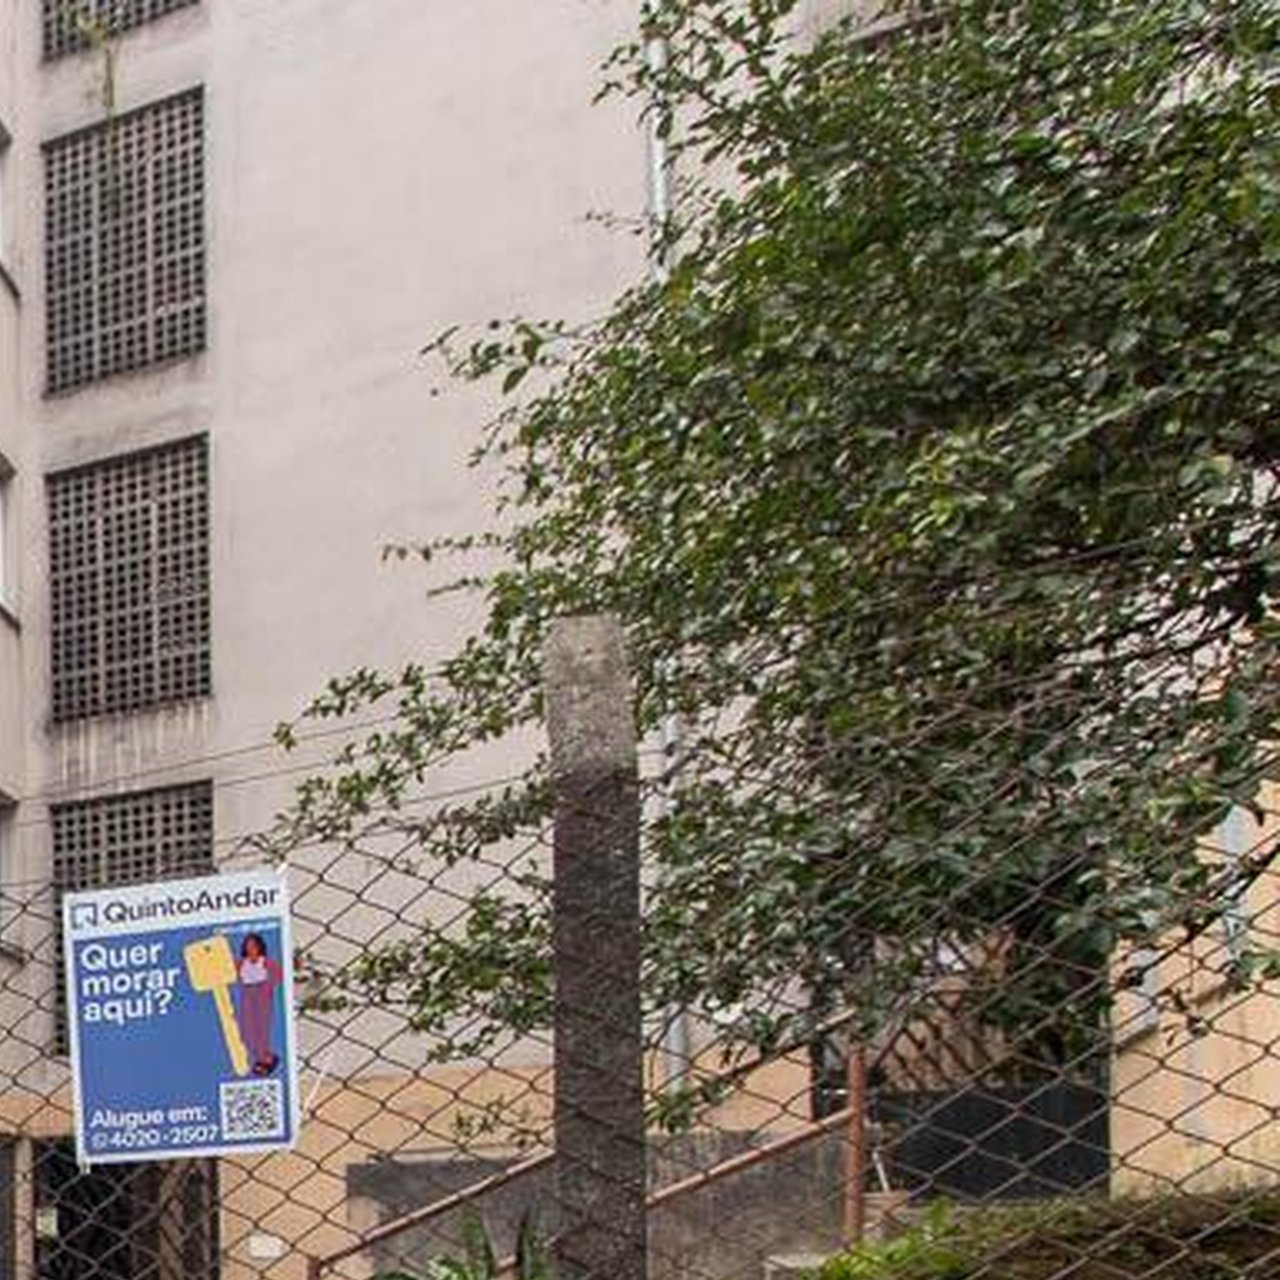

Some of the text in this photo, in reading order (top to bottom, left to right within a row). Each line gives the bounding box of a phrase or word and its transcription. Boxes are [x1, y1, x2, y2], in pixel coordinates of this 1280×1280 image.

[103, 886, 278, 923] QuintoAndar
[81, 942, 164, 971] Quer
[83, 967, 180, 996] morar
[84, 989, 172, 1025] aqui?
[90, 1106, 208, 1129] Alugue em:
